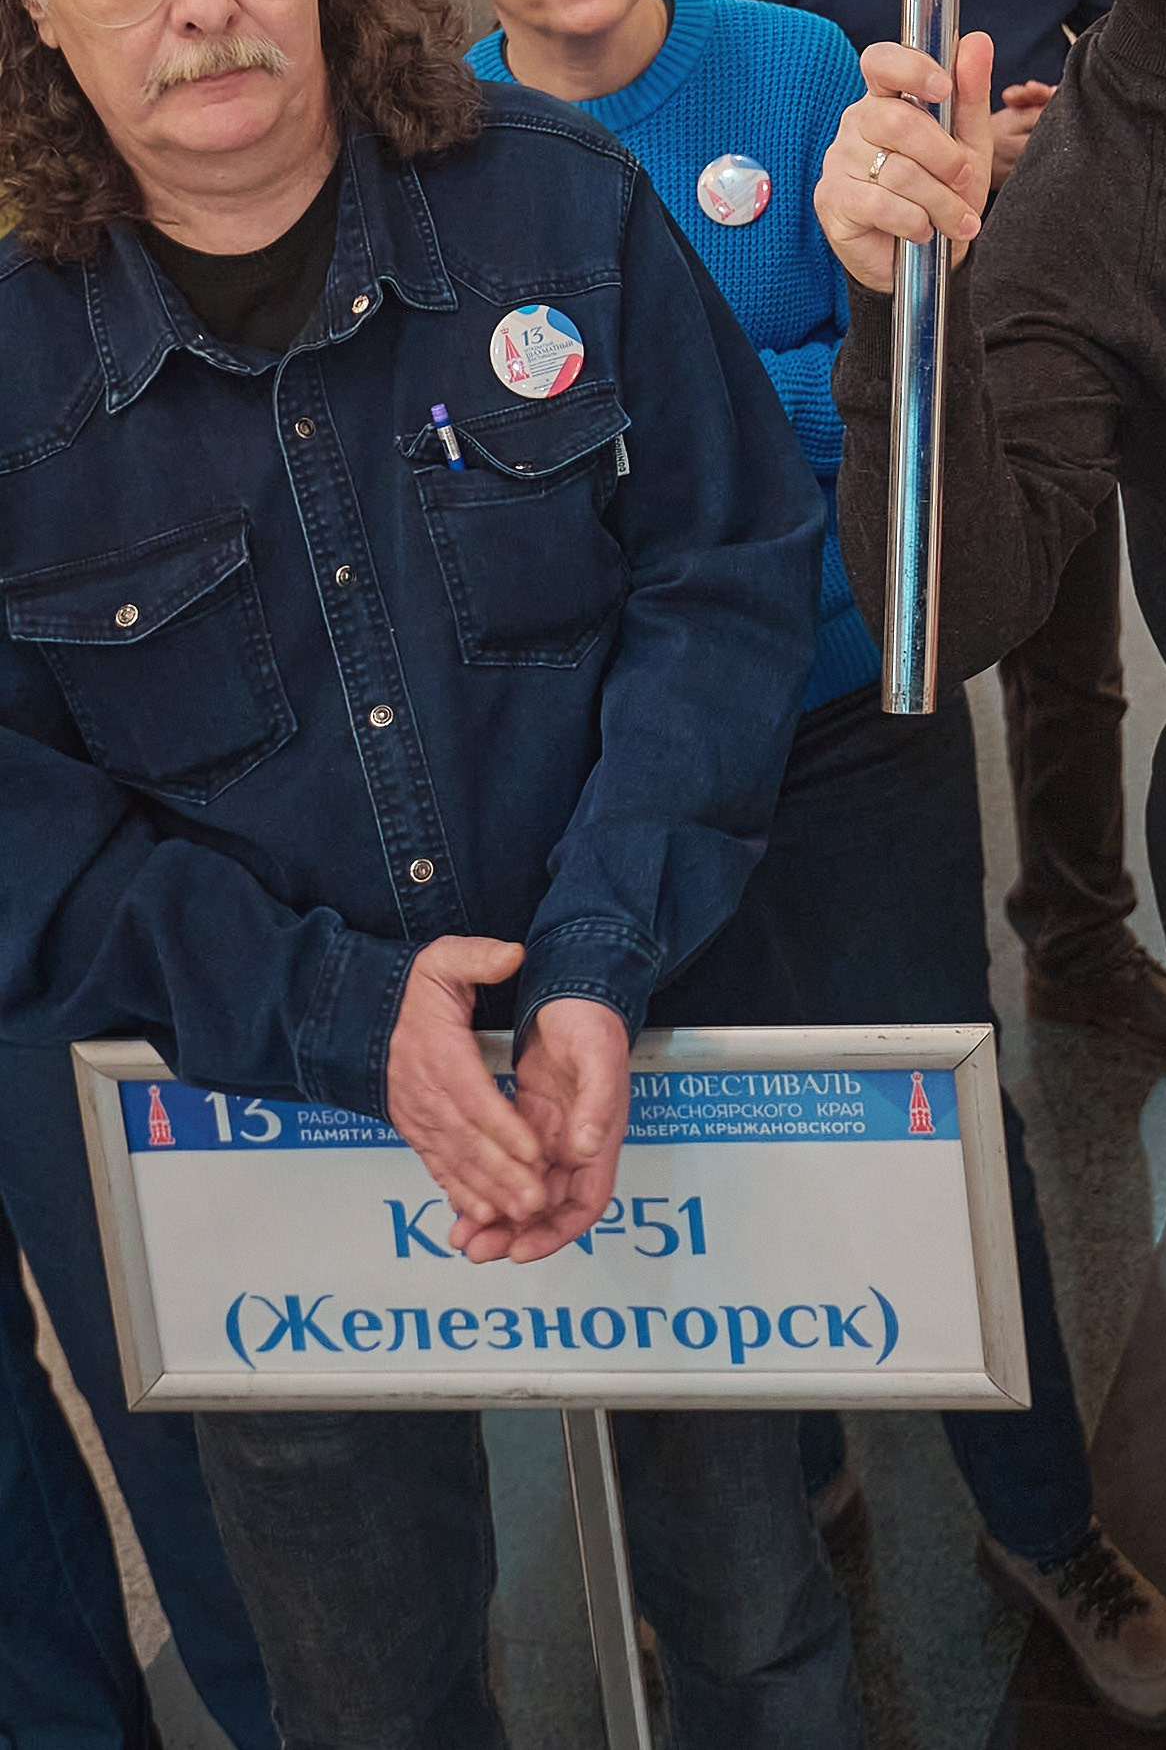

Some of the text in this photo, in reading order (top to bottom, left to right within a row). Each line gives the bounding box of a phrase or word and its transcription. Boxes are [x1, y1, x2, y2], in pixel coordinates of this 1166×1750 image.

[521, 326, 543, 346] 13
[679, 1073, 861, 1098] ФЕСТИВАЛЬ
[205, 1091, 282, 1143] 13
[641, 1102, 802, 1120] КРАСНОЯРСКОГО
[817, 1101, 865, 1117] КРАЯ
[301, 1128, 373, 1142] ПАМЯТИ
[625, 1123, 700, 1137] ЛЬБЕРТА
[705, 1121, 866, 1135] КРЫЖАНОВСКОГО
[384, 1199, 467, 1258] К
[225, 1285, 899, 1371] (Железногорск)
